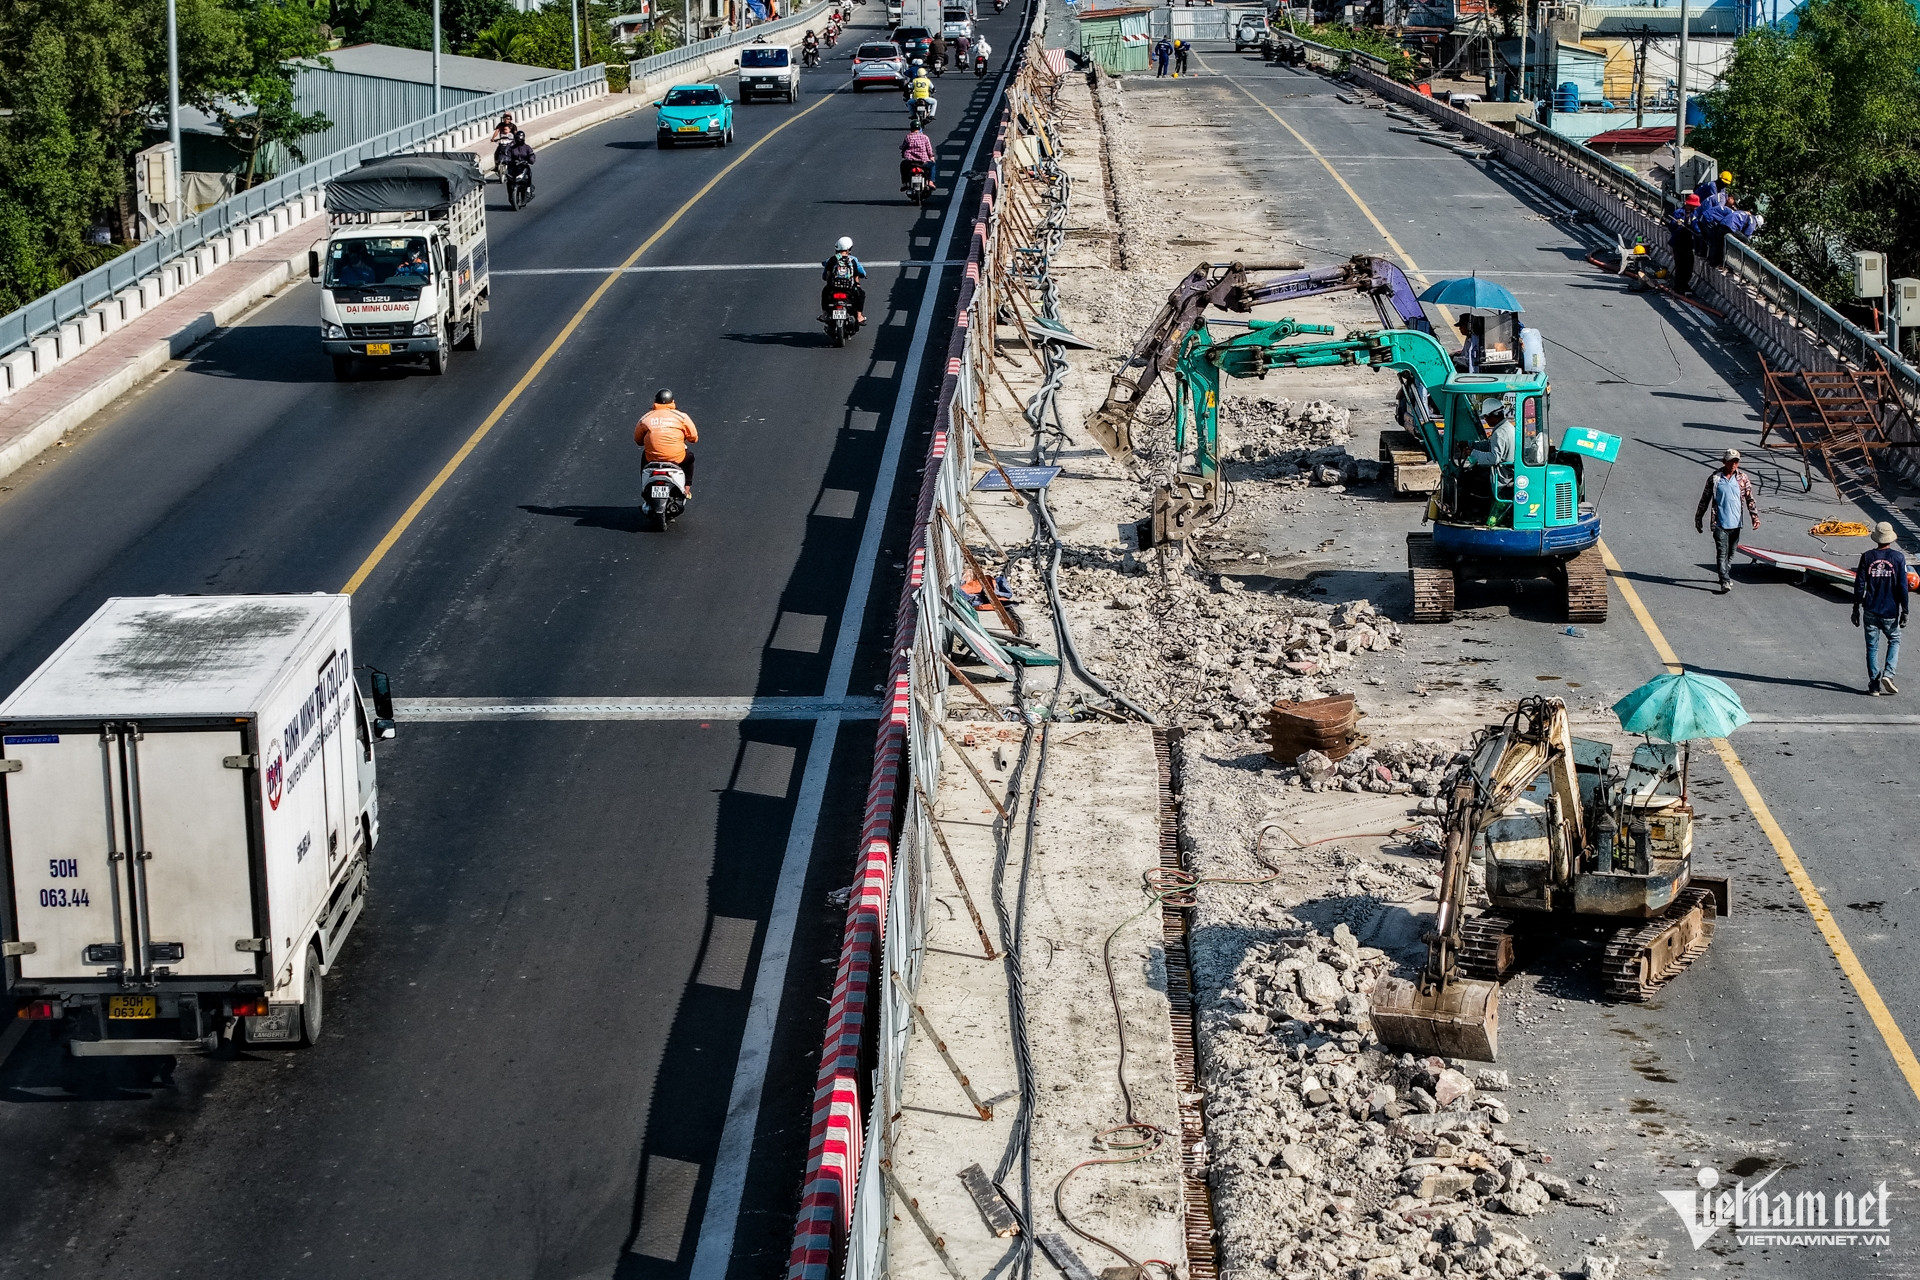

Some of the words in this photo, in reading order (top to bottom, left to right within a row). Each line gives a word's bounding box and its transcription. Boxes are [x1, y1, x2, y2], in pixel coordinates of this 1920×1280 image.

[382, 303, 410, 312] QUANG
[16, 736, 58, 744] LAMBERET
[49, 858, 78, 879] 50H
[39, 888, 90, 908] 063.44
[122, 996, 144, 1007] 50H
[114, 1007, 152, 1018] 063.44
